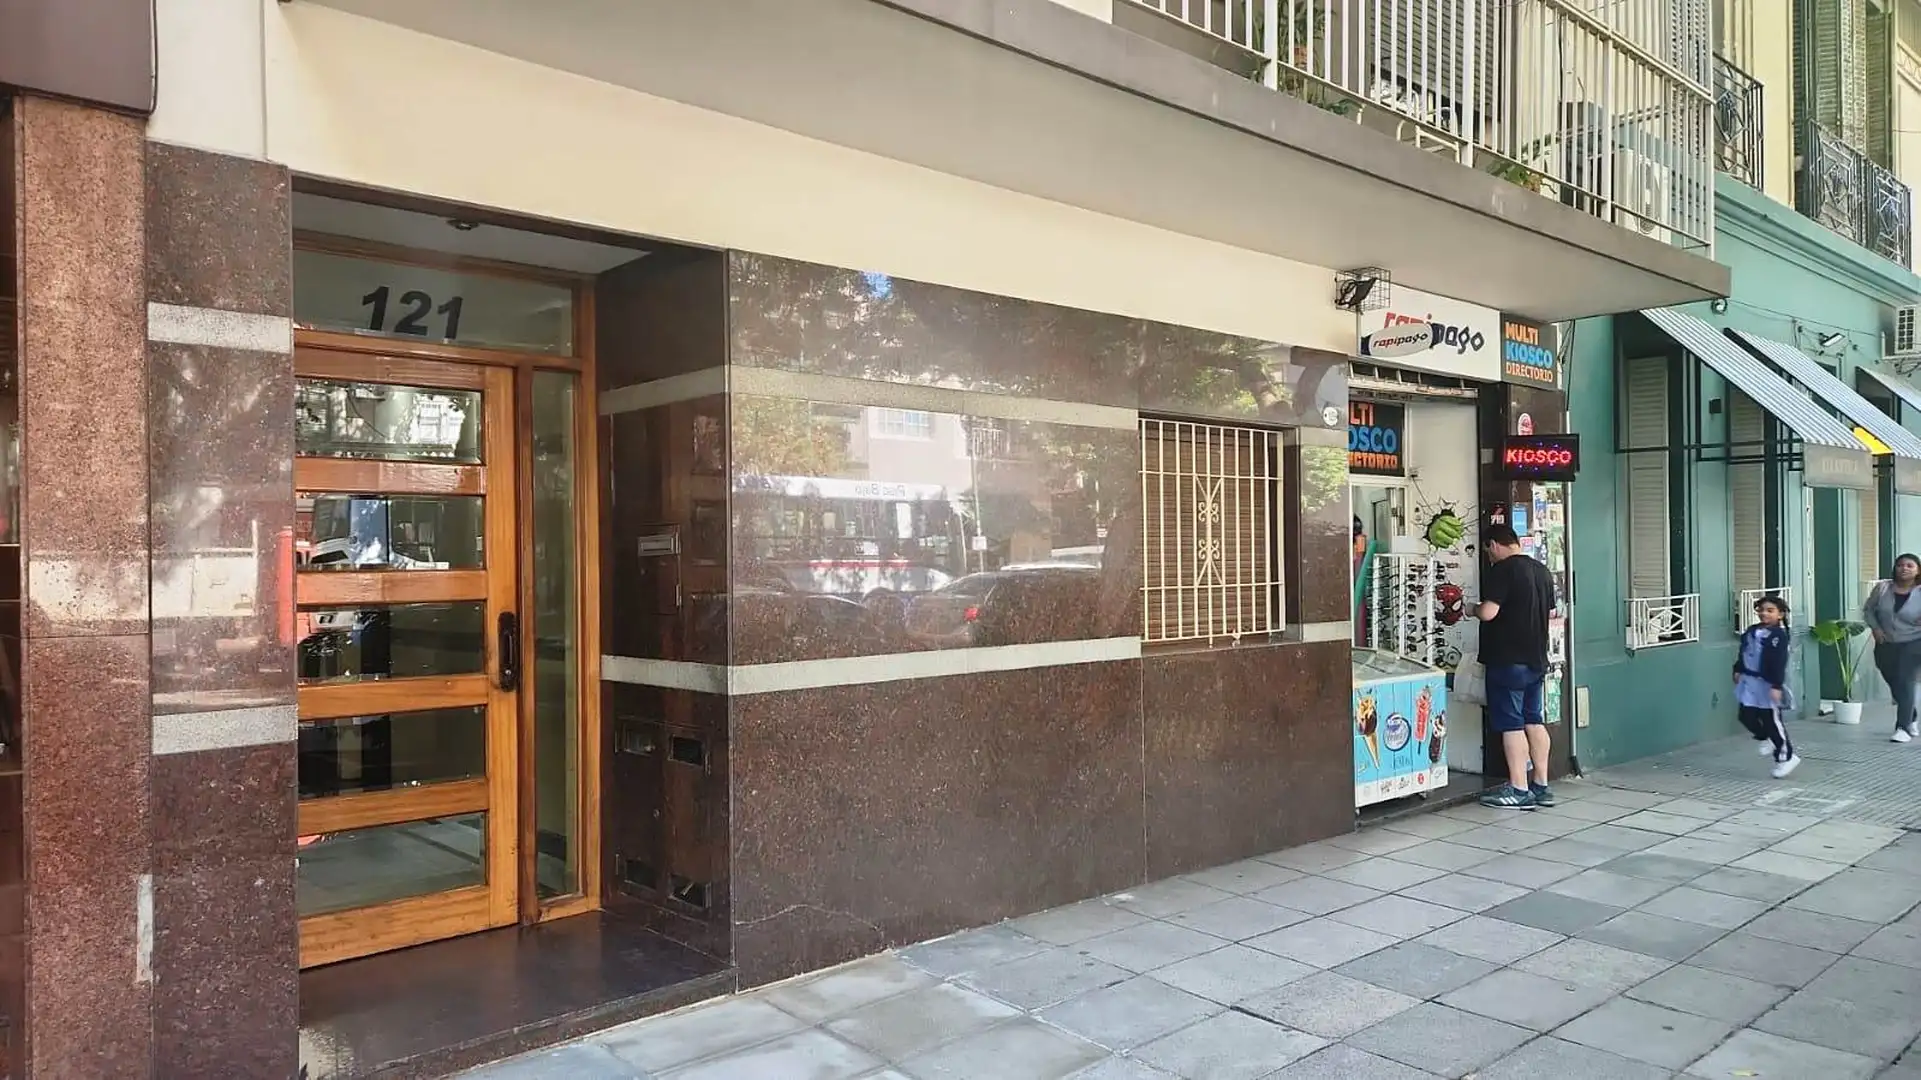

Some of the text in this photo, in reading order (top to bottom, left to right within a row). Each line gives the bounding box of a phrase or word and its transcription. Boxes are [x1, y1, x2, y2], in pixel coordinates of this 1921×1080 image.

[362, 286, 463, 339] 121
[1373, 333, 1429, 349] rapipago
[1505, 322, 1538, 345] MULTI
[1506, 341, 1553, 369] KIOSCO
[1506, 362, 1553, 383] DIRECTORIO
[1350, 402, 1374, 426] LTI
[1349, 426, 1397, 453] OSCO
[1506, 449, 1572, 464] KIOSCO
